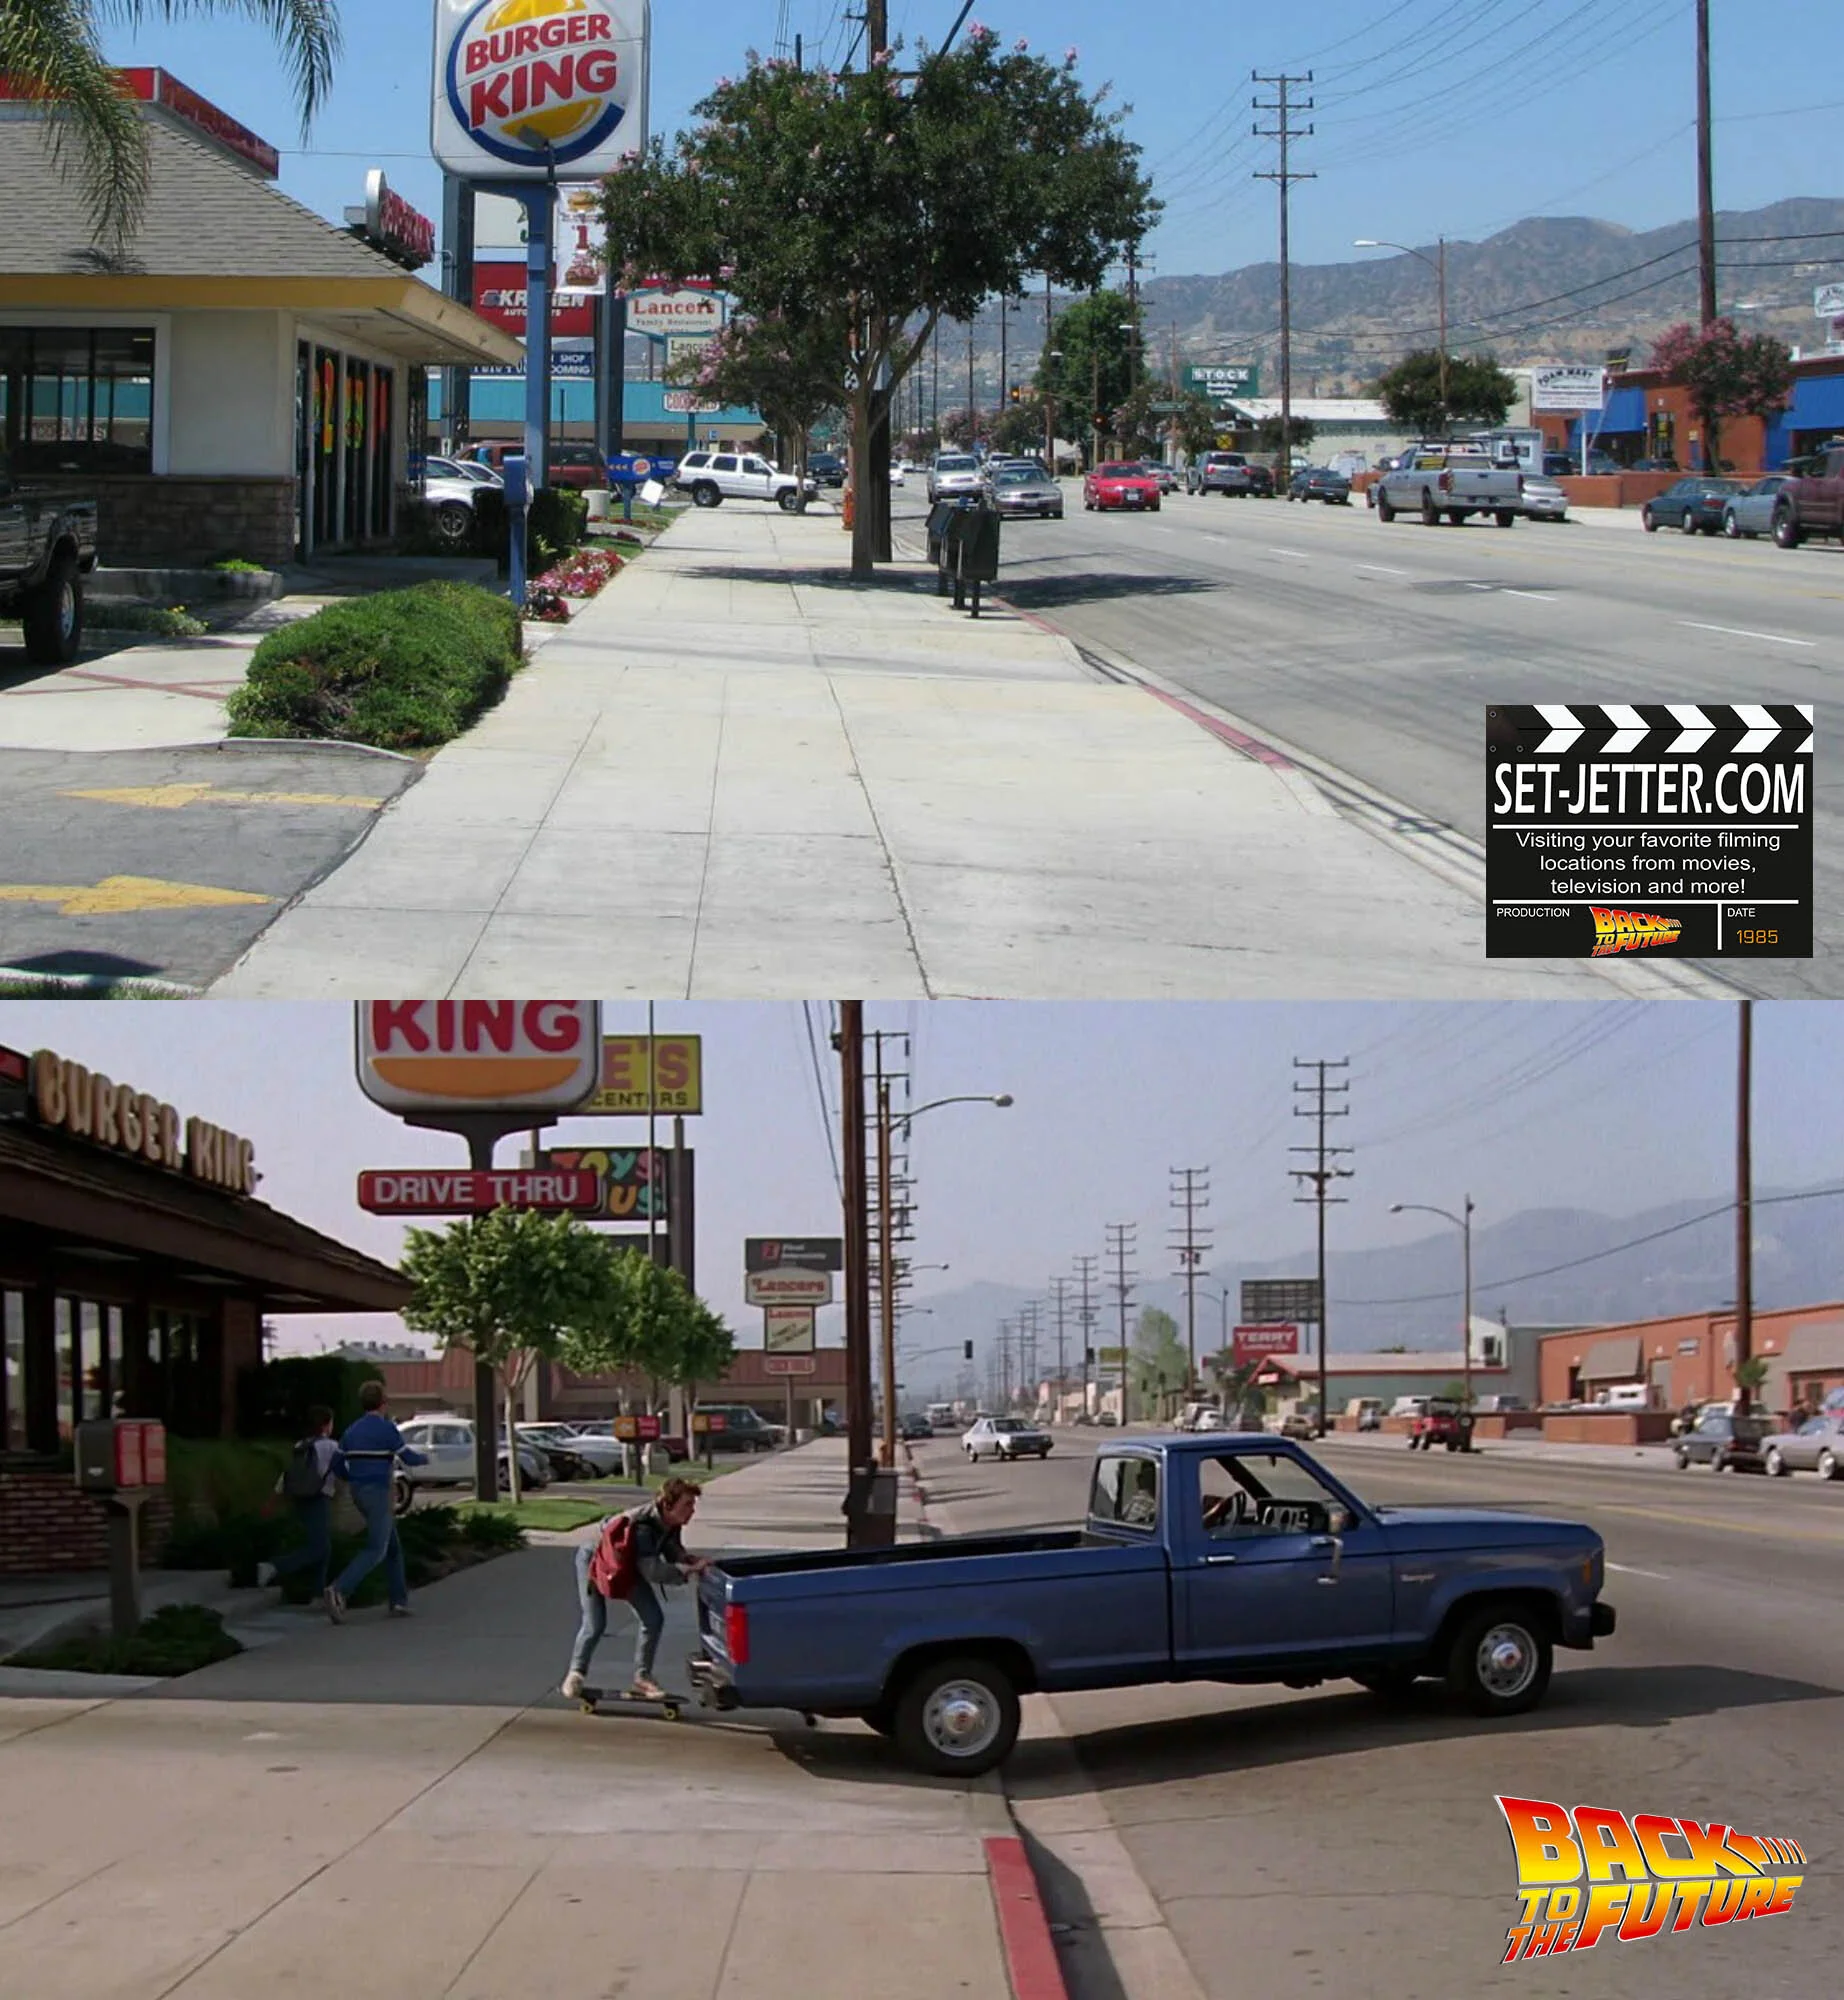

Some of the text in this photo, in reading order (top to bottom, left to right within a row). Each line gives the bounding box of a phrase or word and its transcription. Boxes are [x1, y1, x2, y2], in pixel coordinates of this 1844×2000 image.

[466, 14, 611, 75] BURGER
[470, 49, 617, 129] KING
[500, 289, 585, 307] KREN
[560, 354, 585, 363] SHOP
[1191, 367, 1249, 380] STOCK
[371, 1000, 580, 1052] KING
[33, 1049, 183, 1170] BURGER
[187, 1116, 257, 1195] KING
[374, 1176, 577, 1203] DRIVE THRU
